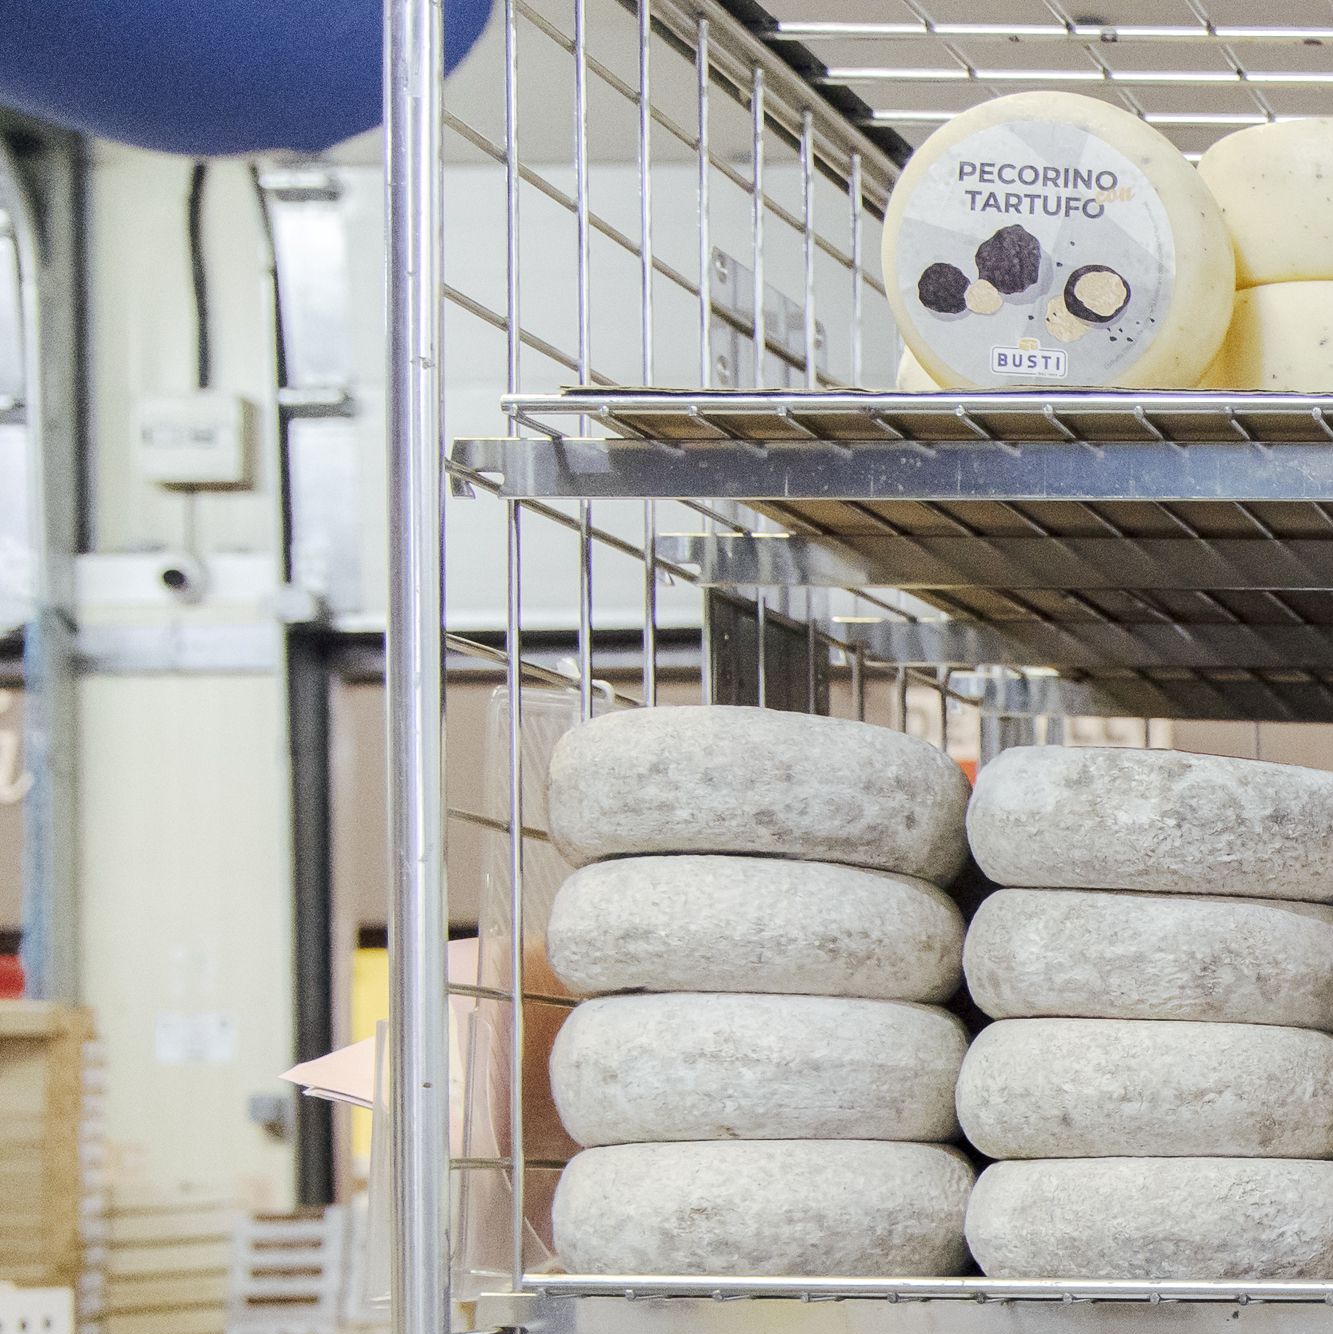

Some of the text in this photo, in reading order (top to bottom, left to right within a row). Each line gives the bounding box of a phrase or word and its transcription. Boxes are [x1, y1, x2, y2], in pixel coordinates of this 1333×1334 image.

[958, 161, 1118, 192] PECORINO
[964, 190, 1105, 219] TARTUFO
[997, 352, 1060, 371] BUSTI
